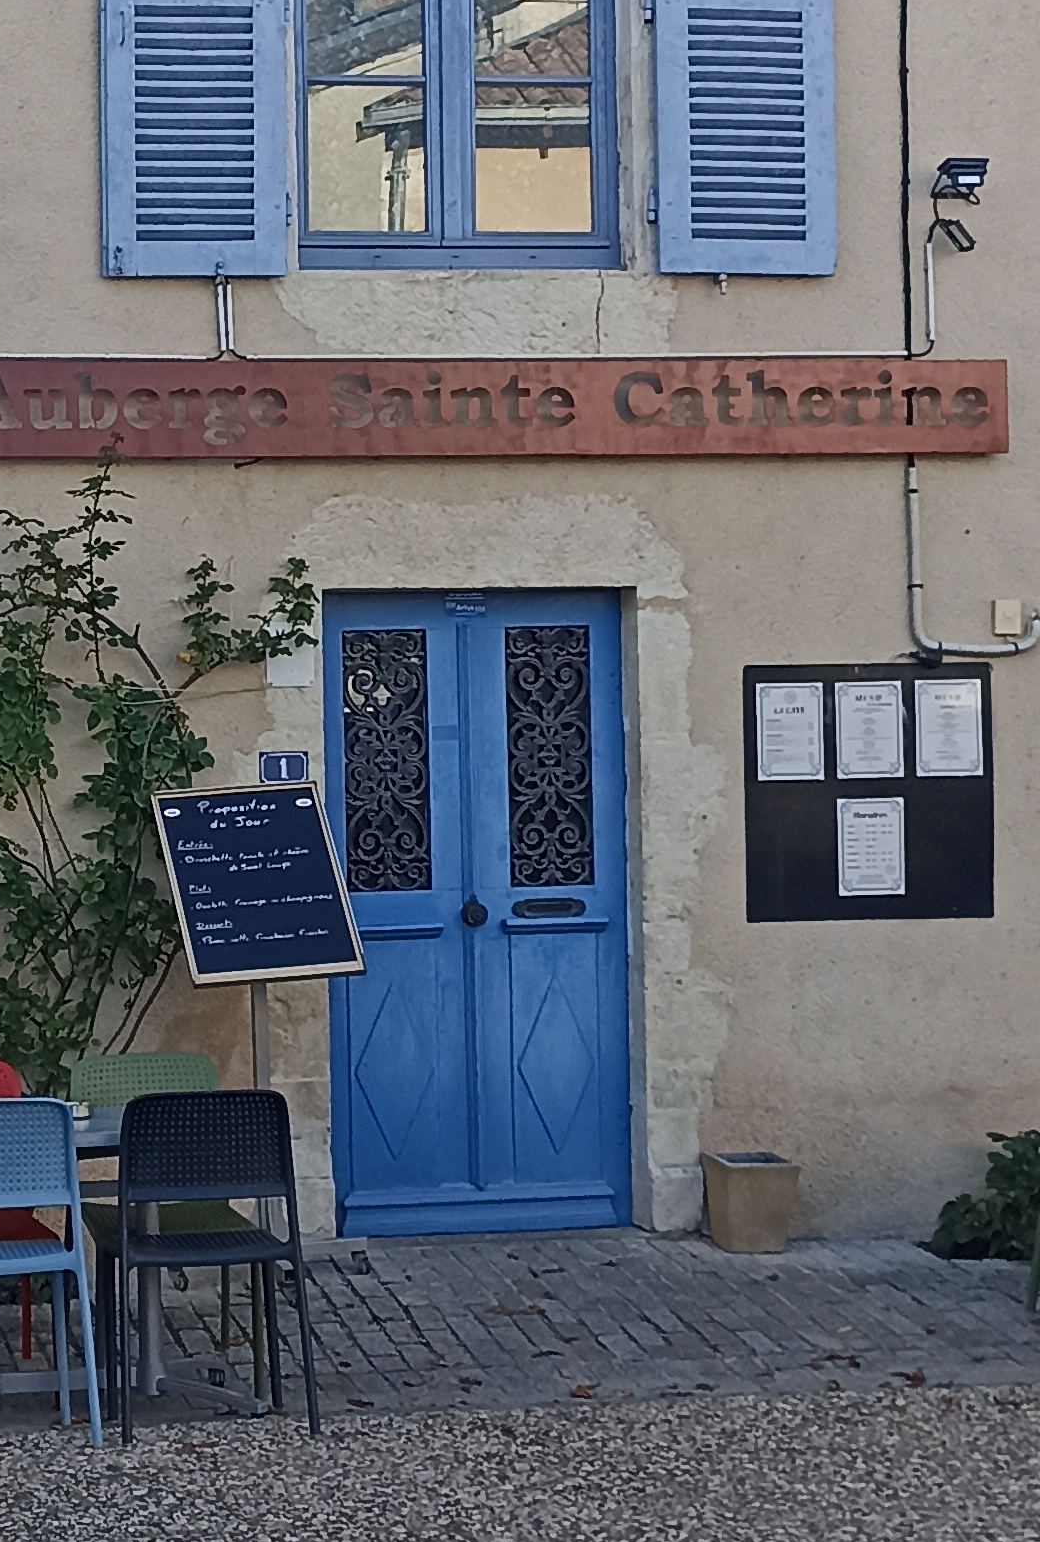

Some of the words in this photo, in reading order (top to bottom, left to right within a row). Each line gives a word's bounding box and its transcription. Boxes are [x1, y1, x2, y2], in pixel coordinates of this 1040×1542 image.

[328, 370, 576, 429] Sainte
[613, 369, 990, 428] Catherine
[279, 757, 290, 780] 1
[196, 798, 277, 816] Proposition
[210, 819, 227, 829] du
[234, 816, 271, 828] Jour
